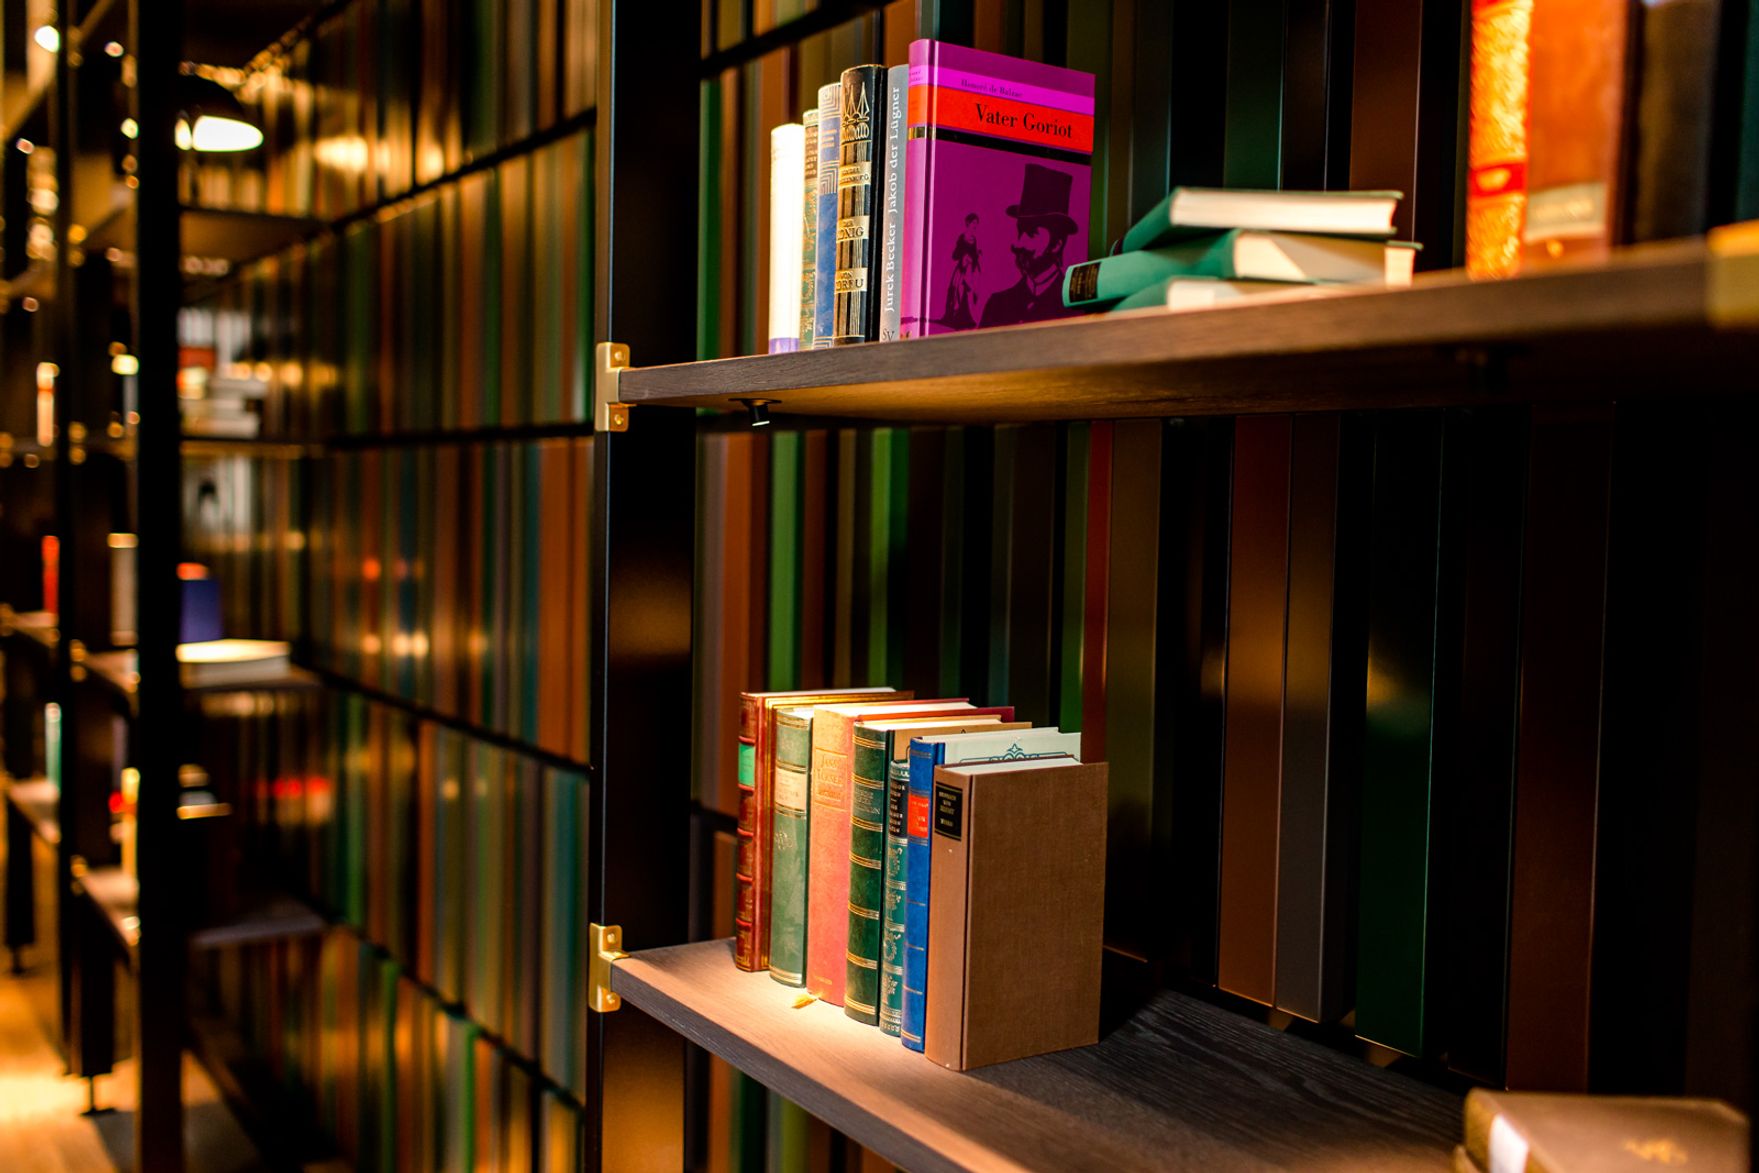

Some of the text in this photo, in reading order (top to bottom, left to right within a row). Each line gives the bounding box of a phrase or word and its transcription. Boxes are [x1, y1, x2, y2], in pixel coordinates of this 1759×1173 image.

[975, 102, 1073, 139] Vater Goriot
[885, 87, 902, 312] Jurek Becker Jakob der Lügner
